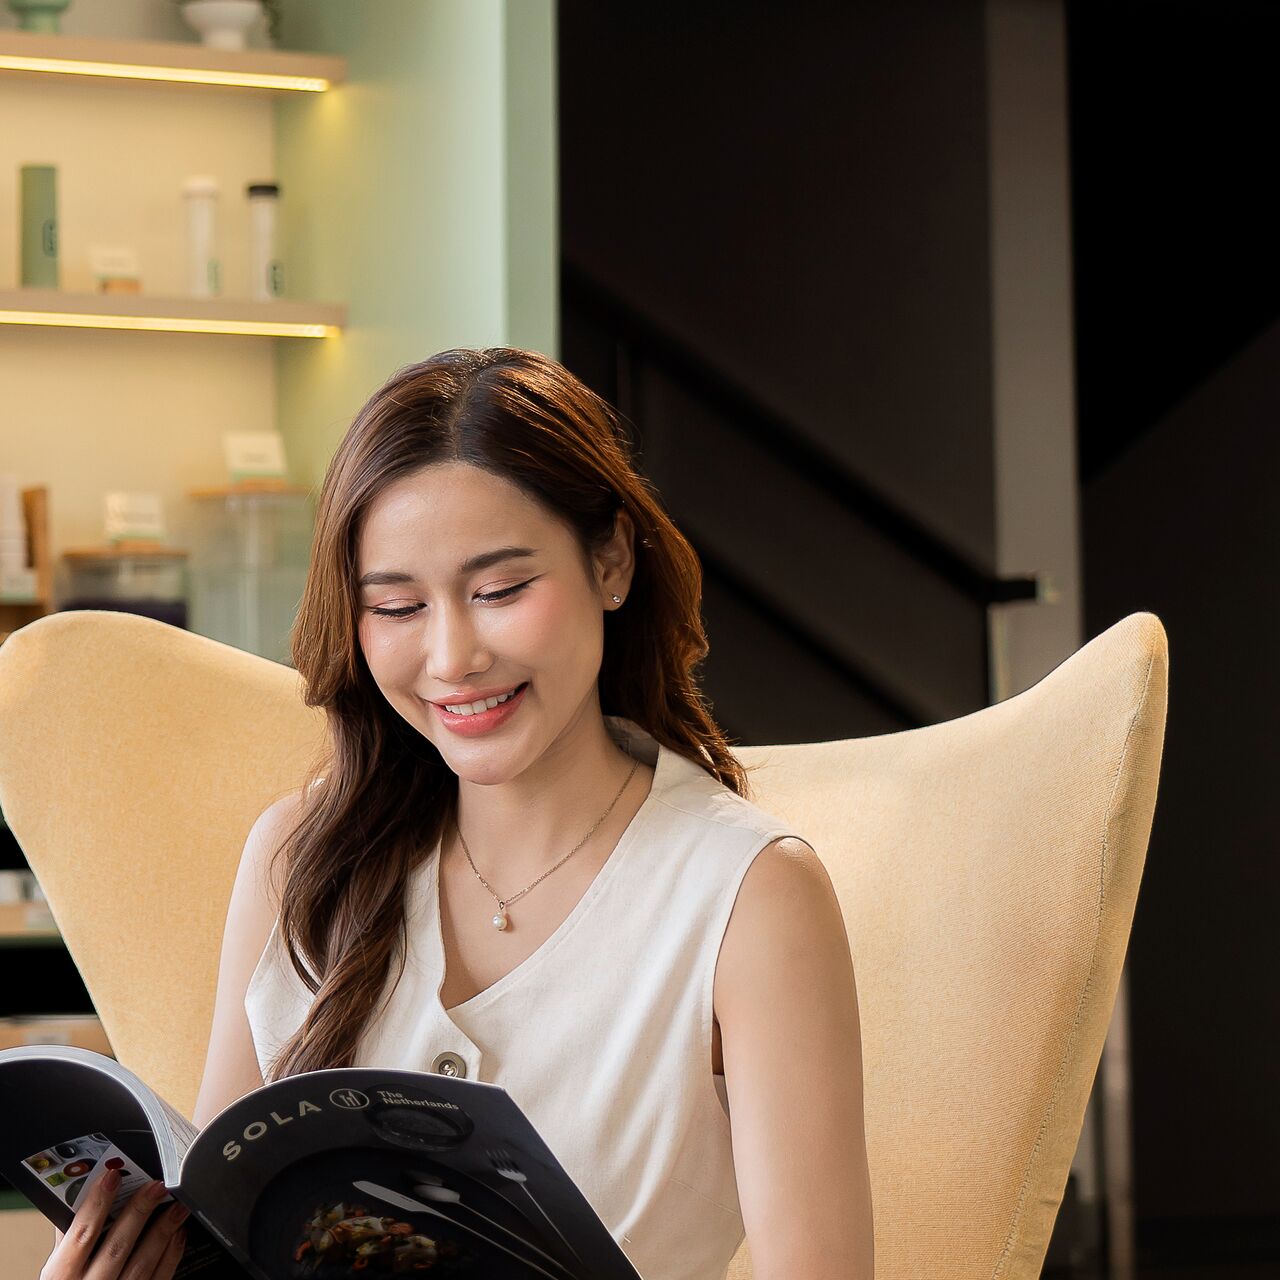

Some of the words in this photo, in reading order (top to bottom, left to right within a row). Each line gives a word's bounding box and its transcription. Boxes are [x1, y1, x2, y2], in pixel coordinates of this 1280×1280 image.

[376, 1090, 403, 1098] The
[382, 1097, 460, 1111] Netherlands
[222, 1099, 322, 1161] SOLA
